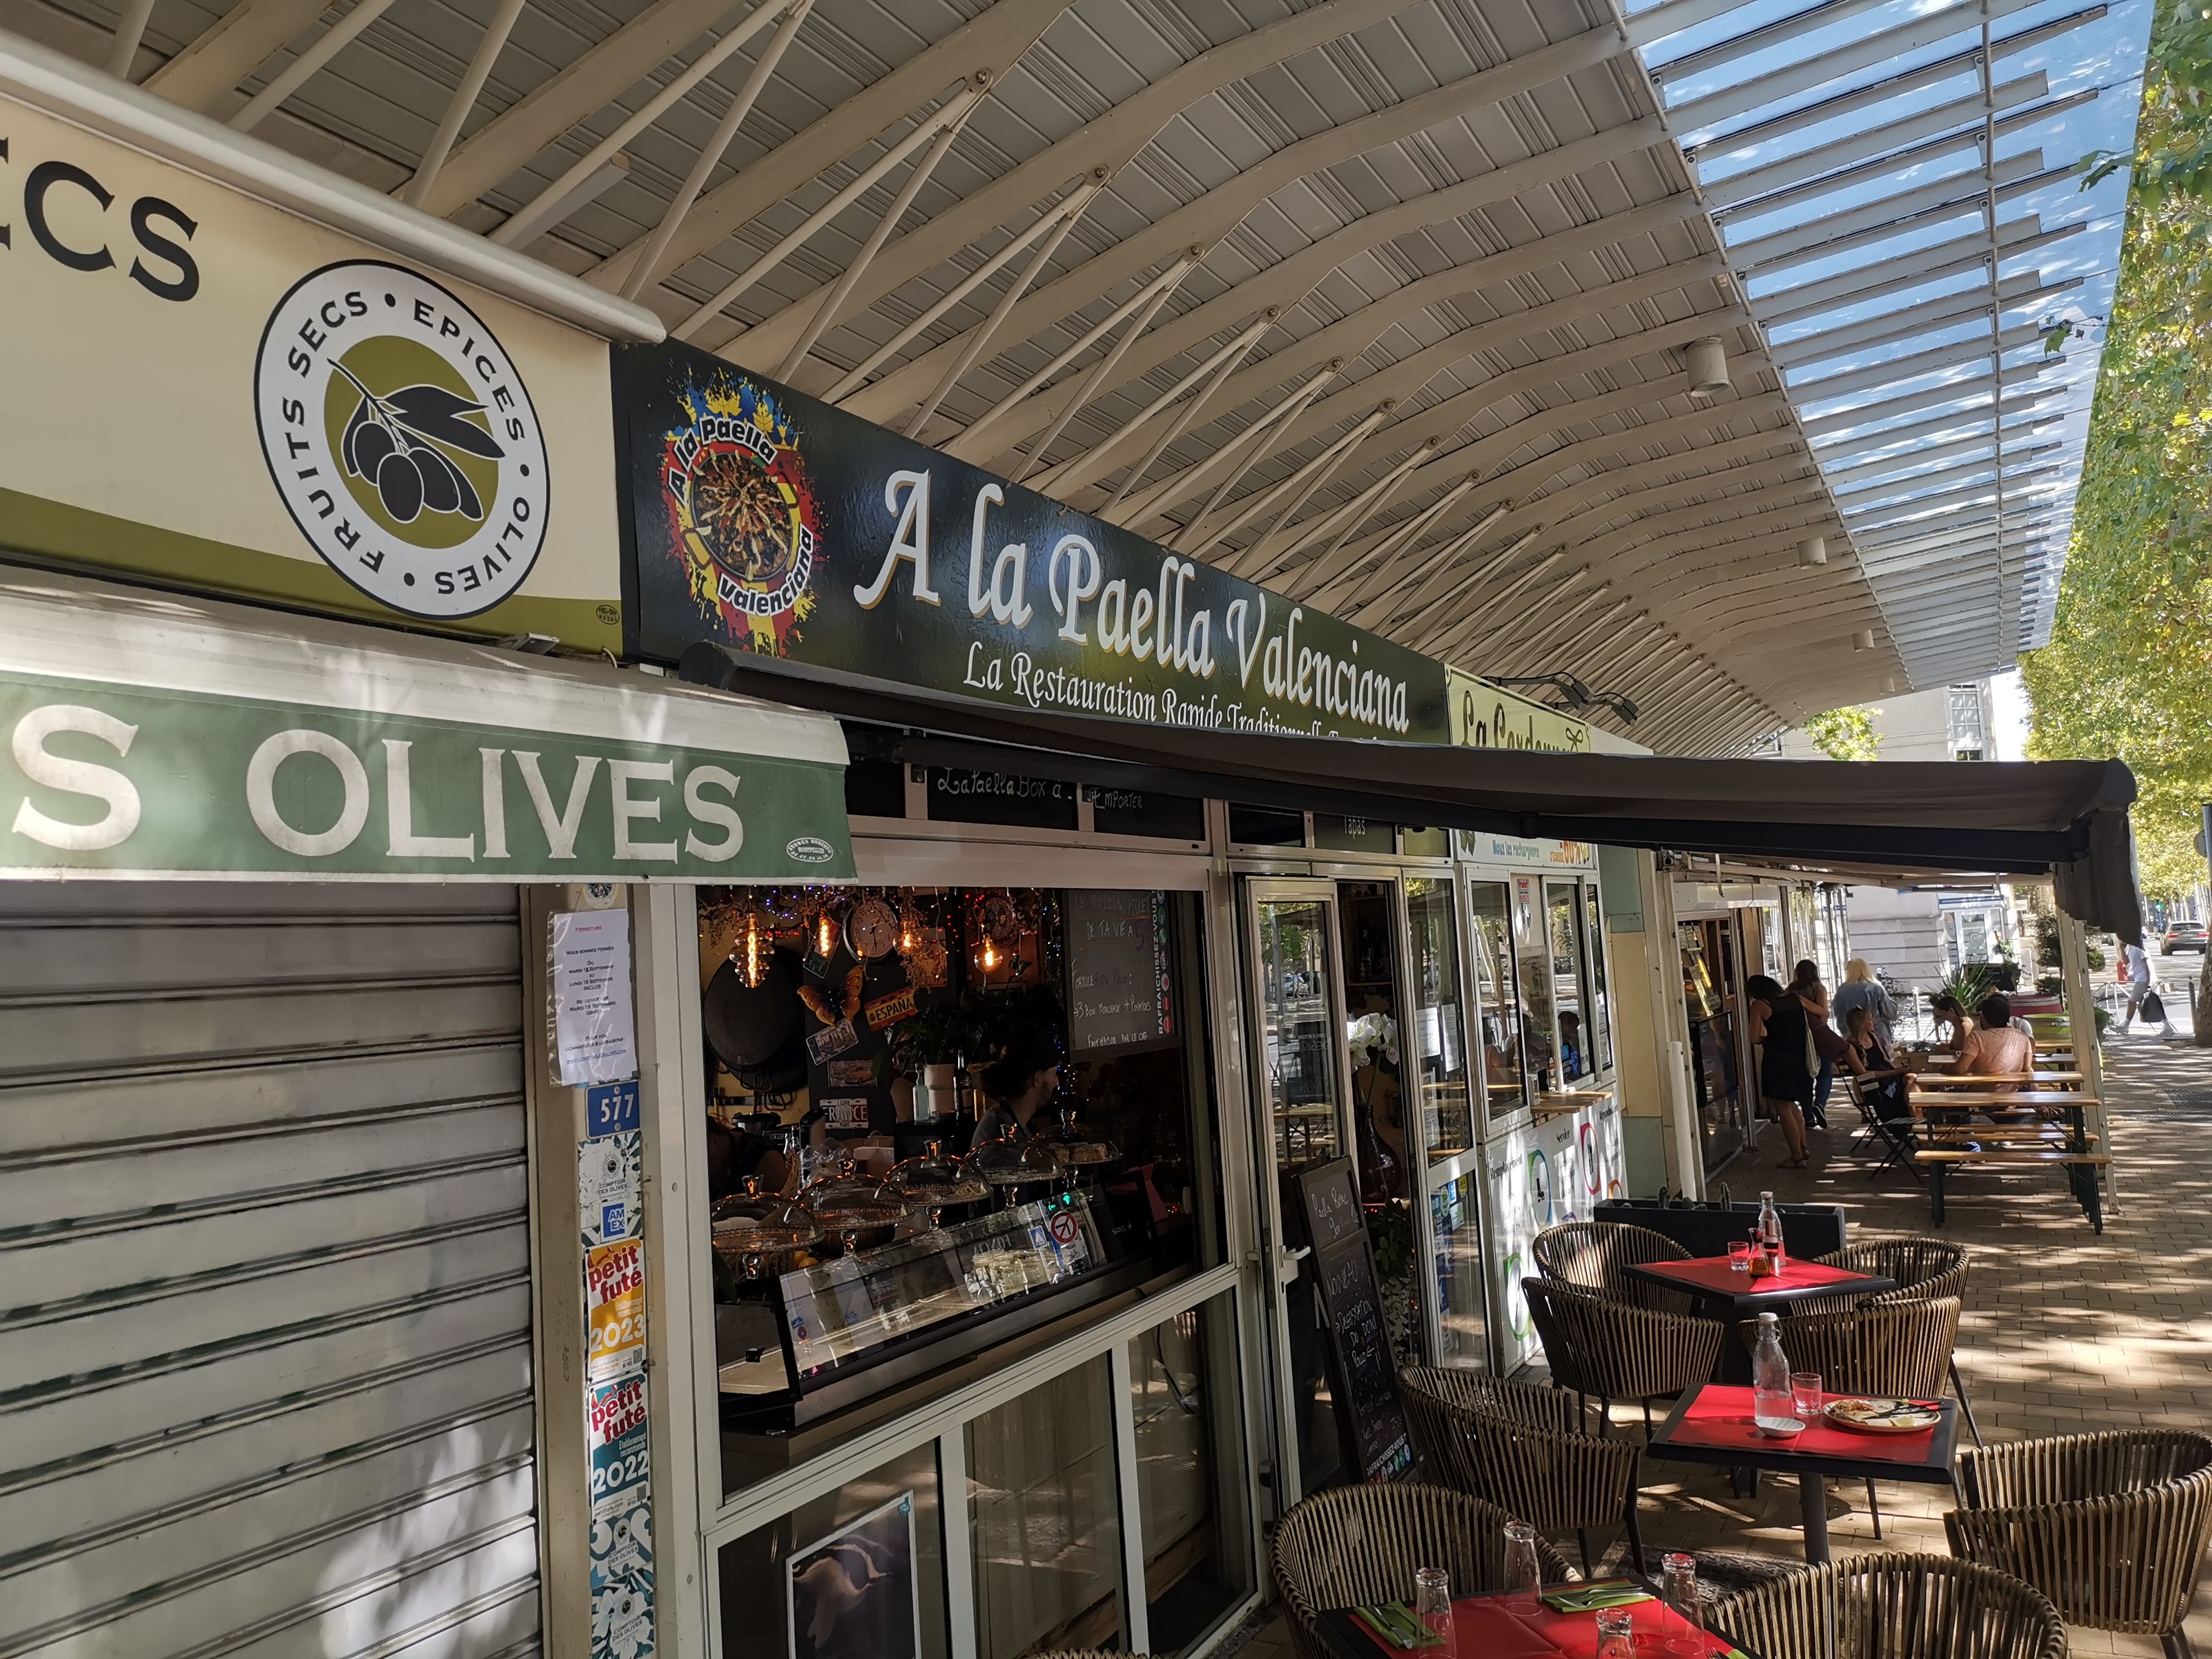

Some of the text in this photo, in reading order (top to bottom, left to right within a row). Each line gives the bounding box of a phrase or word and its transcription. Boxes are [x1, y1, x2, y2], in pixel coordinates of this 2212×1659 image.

[0, 136, 199, 302] CS
[413, 298, 526, 441] EPICES
[283, 292, 386, 574] FRUITS SECS
[674, 428, 700, 470] la
[700, 416, 778, 465] Paella
[438, 498, 530, 595] OLIVES
[853, 468, 1410, 735] A la Paella Valenciana
[963, 641, 1003, 691] La
[1011, 652, 1157, 722] Restauration
[246, 729, 745, 864] OLIVES
[1151, 897, 1164, 1035] RAFRAICHISSEZ-VOUS
[601, 1093, 634, 1123] 577
[599, 1178, 625, 1189] COMPTOIR
[609, 1183, 628, 1192] OLIVES
[1490, 1154, 1524, 1181] Remplacement
[588, 1244, 639, 1293] petit
[600, 1265, 643, 1306] futé
[590, 1313, 646, 1354] 2023
[591, 1379, 643, 1433] petit
[603, 1401, 646, 1444] futé
[593, 1450, 649, 1495] 2022
[609, 1541, 637, 1559] COMPTOIR
[619, 1546, 639, 1561] OLIVES
[614, 1615, 641, 1635] COMPTOIR
[624, 1621, 643, 1637] OLIVES
